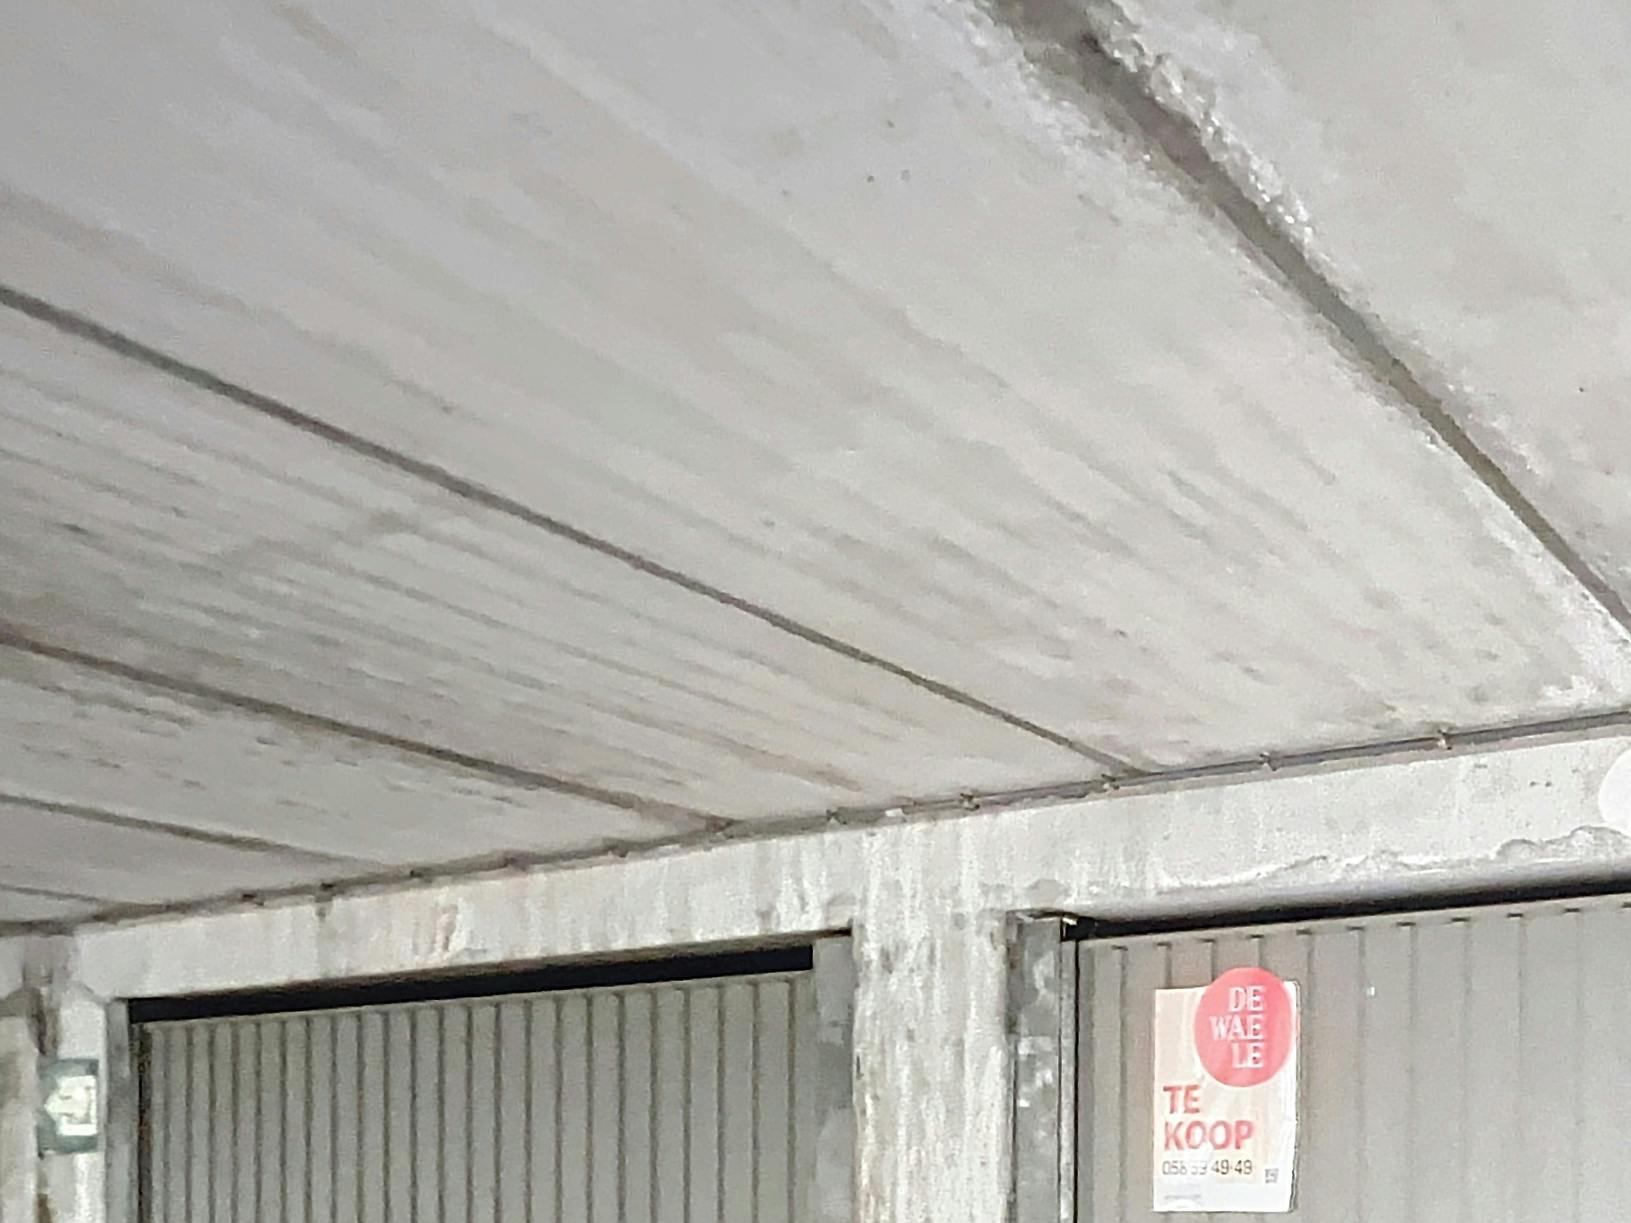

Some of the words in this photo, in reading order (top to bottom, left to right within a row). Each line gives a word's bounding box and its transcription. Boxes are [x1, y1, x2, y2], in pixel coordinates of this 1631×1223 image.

[1228, 984, 1265, 1012] DE
[1209, 1014, 1265, 1041] WAE
[1230, 1042, 1265, 1069] LE
[1163, 1084, 1201, 1114] TE
[1163, 1119, 1255, 1151] KOOP
